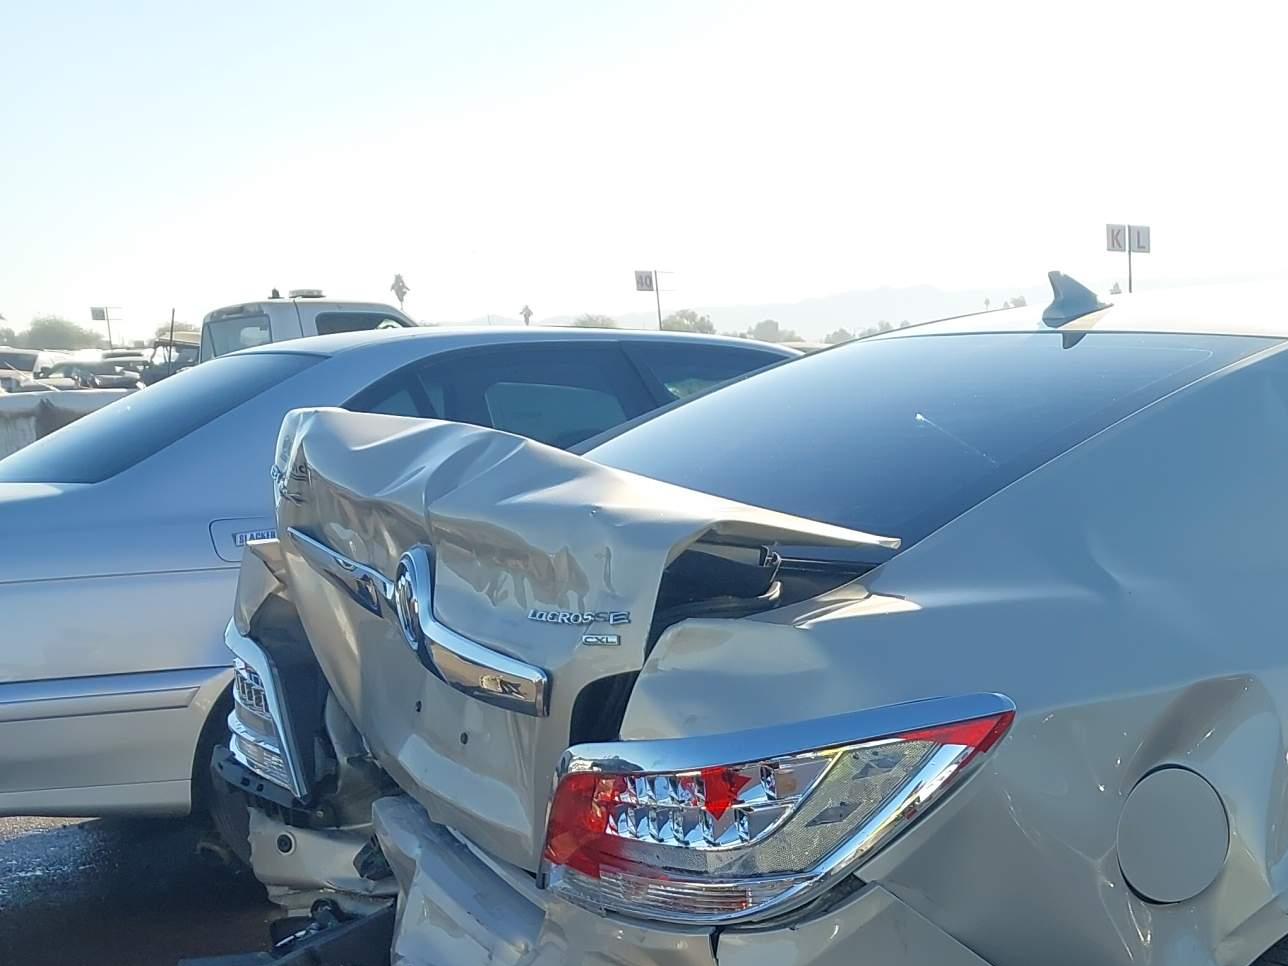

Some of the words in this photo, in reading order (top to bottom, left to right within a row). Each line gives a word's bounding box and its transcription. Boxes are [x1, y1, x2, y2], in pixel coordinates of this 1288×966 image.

[1111, 229, 1122, 249] K
[1136, 230, 1146, 249] L
[583, 635, 618, 645] CXL
